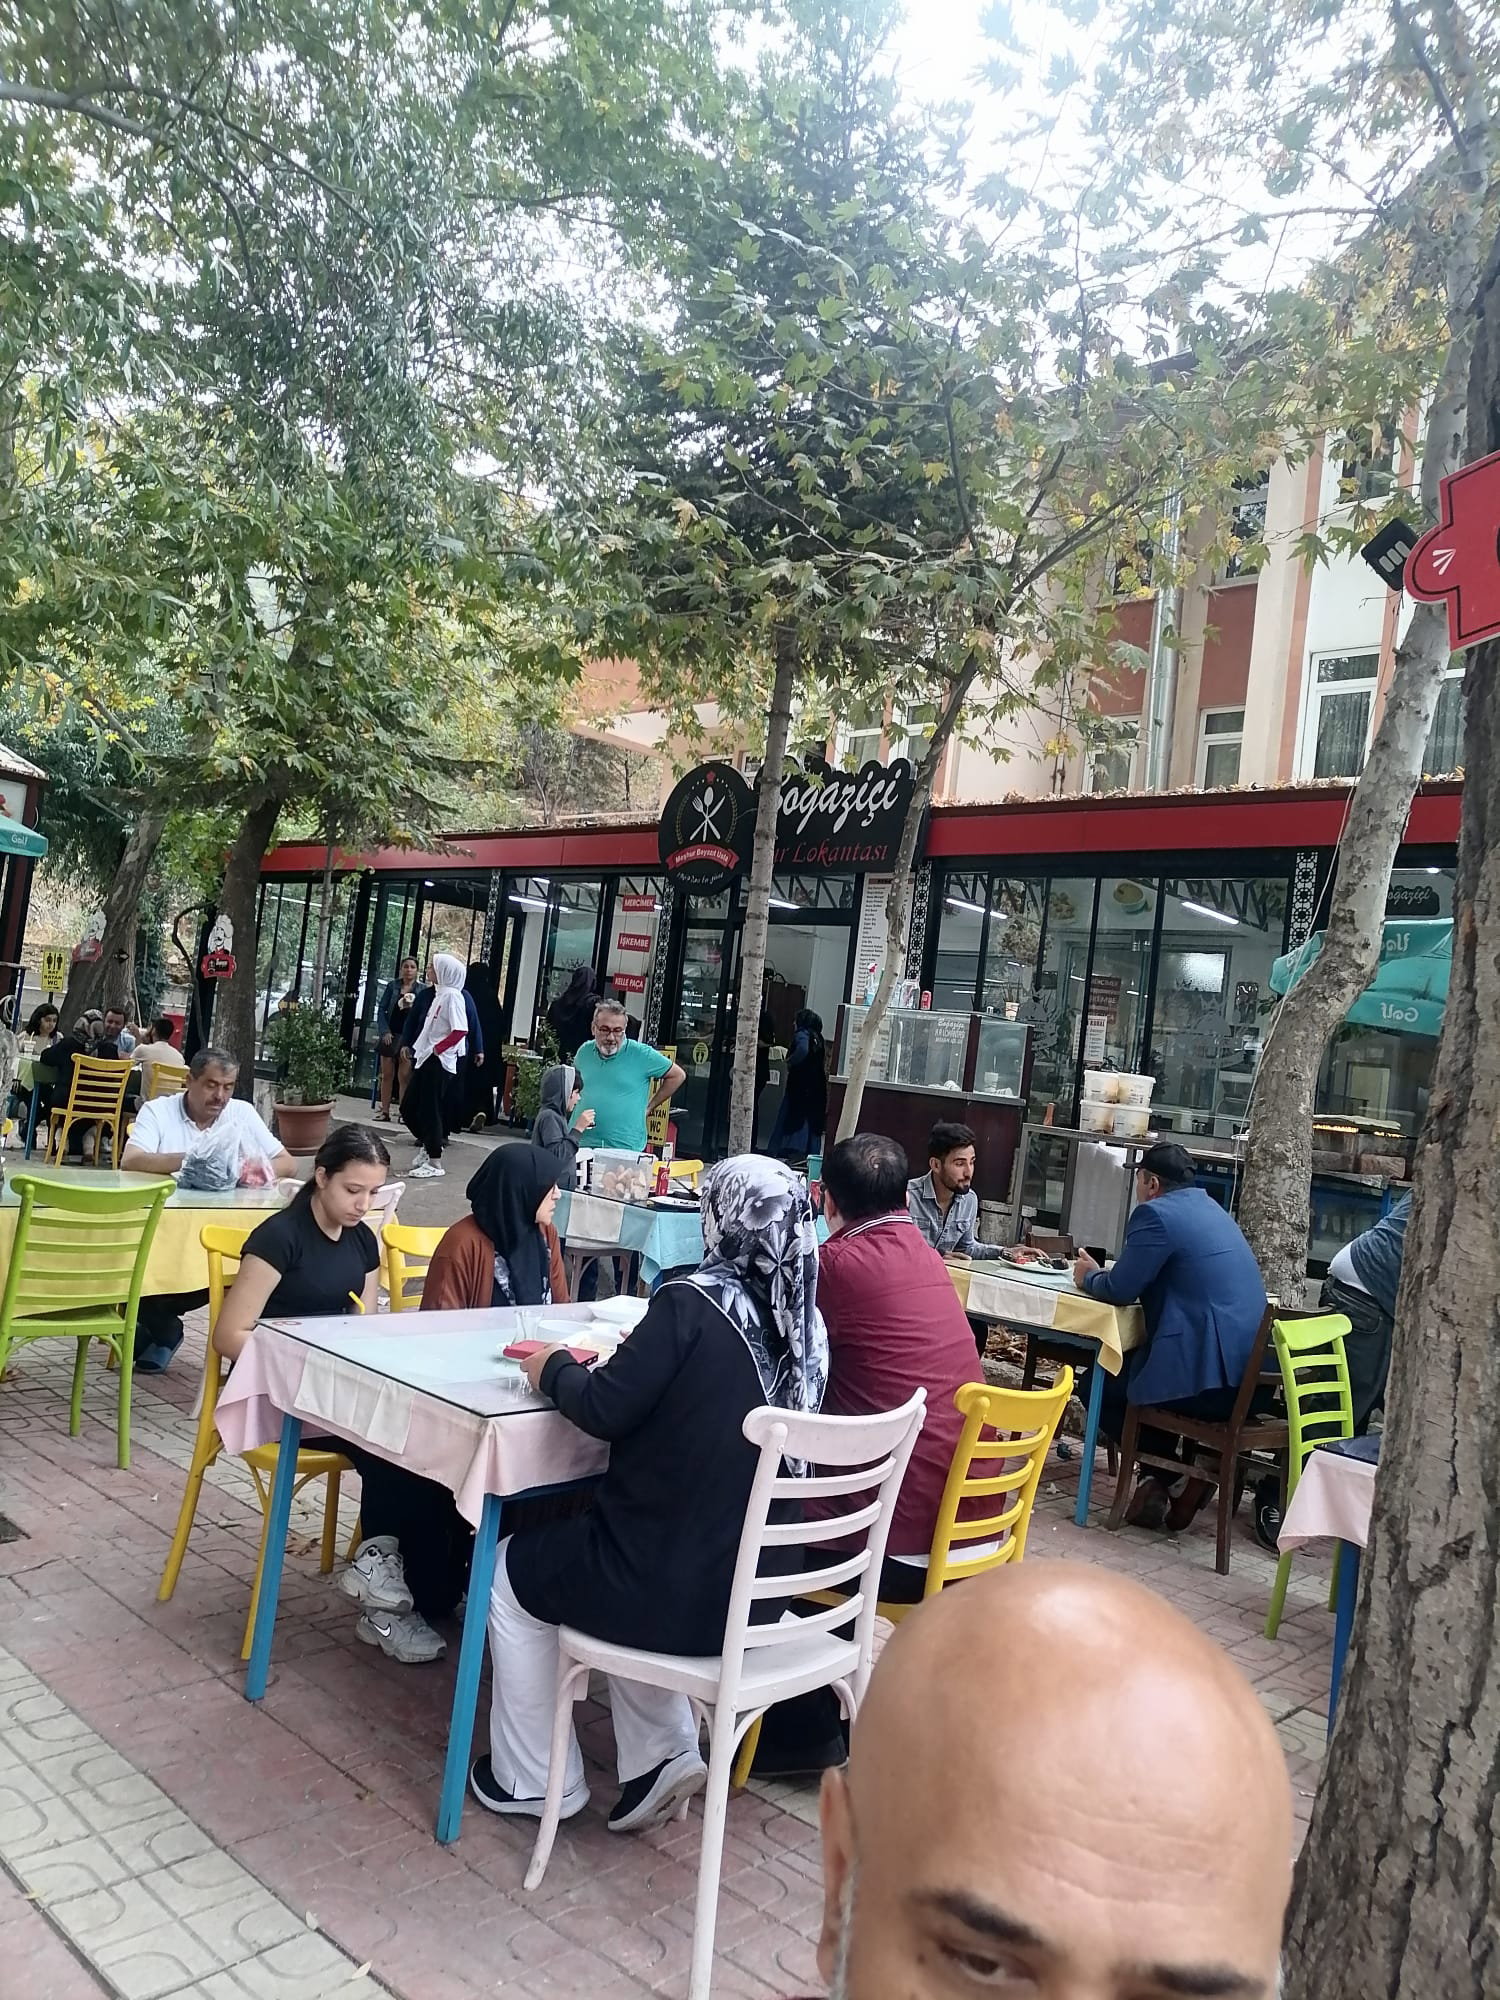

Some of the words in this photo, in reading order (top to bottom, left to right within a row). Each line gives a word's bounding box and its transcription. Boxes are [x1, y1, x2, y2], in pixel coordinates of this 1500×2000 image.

[792, 838, 888, 867] Lokantası
[619, 935, 649, 948] İŞKEMBE
[629, 979, 644, 990] PAÇA
[650, 1120, 661, 1133] WC
